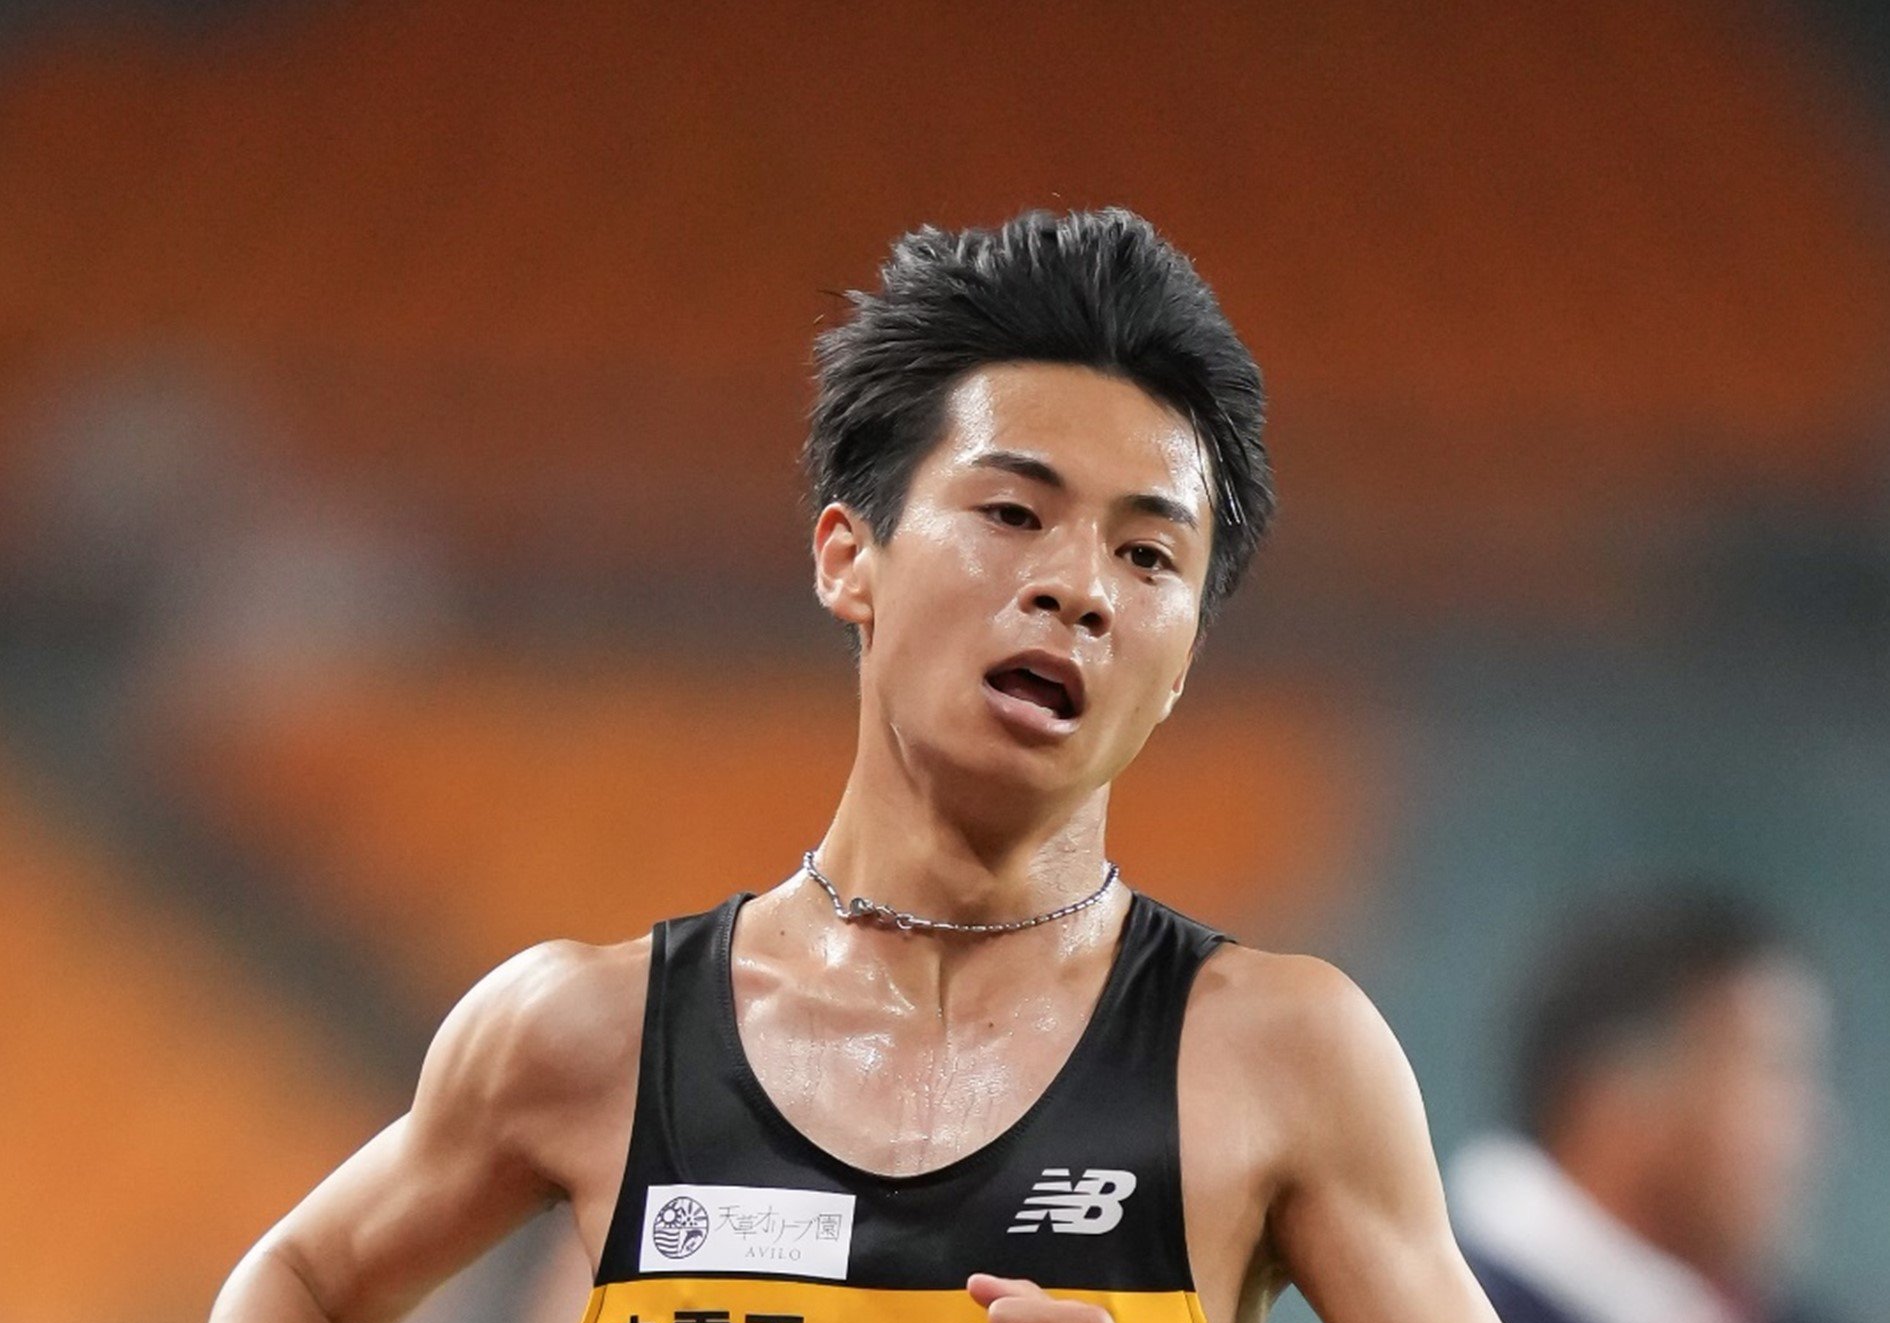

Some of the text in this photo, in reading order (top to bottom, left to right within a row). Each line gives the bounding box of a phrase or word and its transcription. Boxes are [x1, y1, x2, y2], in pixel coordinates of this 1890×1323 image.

[1007, 1168, 1137, 1235] NB
[715, 1205, 842, 1244] 天草オリーブ園
[745, 1247, 802, 1261] AVILO
